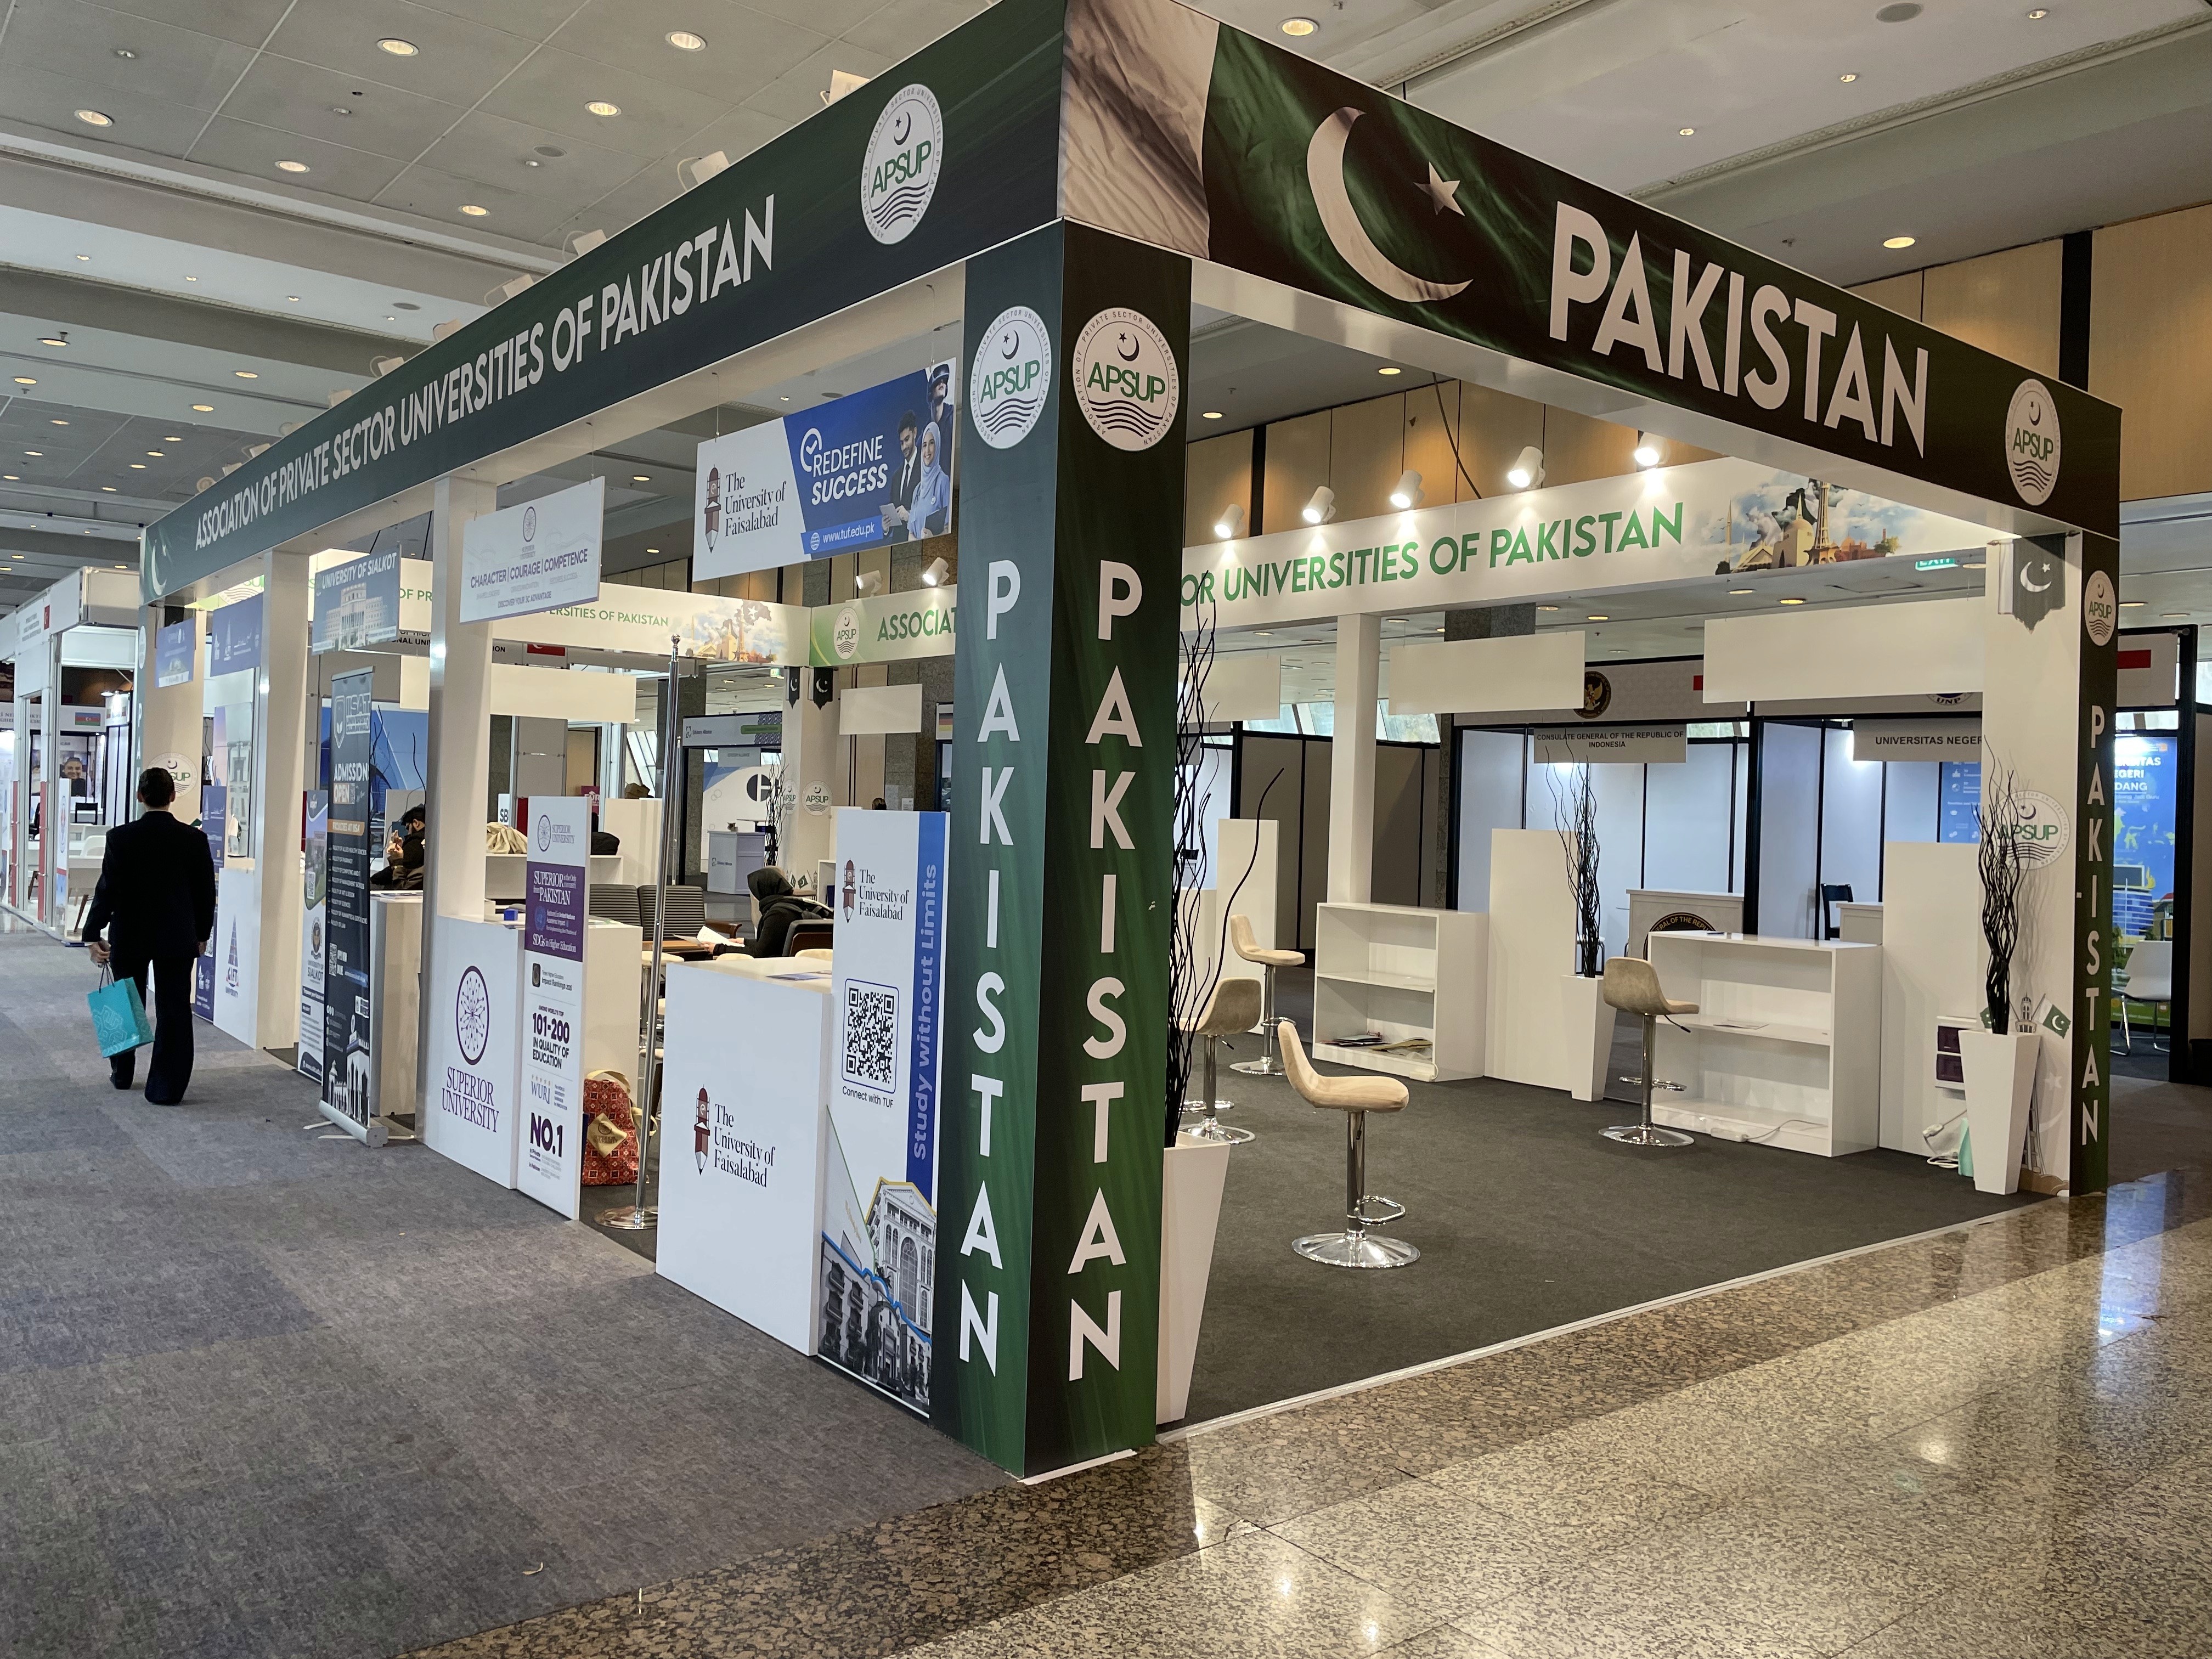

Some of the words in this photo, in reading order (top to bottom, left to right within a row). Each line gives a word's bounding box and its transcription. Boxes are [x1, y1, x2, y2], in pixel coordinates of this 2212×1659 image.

[870, 140, 932, 198] APSUP
[1549, 200, 1929, 459] PAKISTAN
[196, 481, 258, 551] ASSOCIATION
[261, 471, 277, 516] OF
[279, 440, 330, 508] PRIVATE
[332, 405, 396, 480] SECTOR
[400, 322, 544, 446] UNIVERSITIES
[551, 294, 594, 372] OF
[601, 194, 774, 351] PAKISTAN
[980, 359, 1040, 403] APSUP
[1087, 362, 1166, 403] APSUP
[812, 435, 883, 478] REDEFINE
[2013, 427, 2053, 462] APSUP
[725, 472, 745, 493] The
[725, 488, 774, 516] University
[775, 481, 787, 503] of
[811, 462, 889, 506] SUCCESS
[725, 506, 778, 537] Faisalabad
[822, 521, 876, 545] www.tuf.edu.pk
[471, 569, 507, 589] CHARACTER
[510, 561, 541, 580] COURAGE
[544, 549, 588, 572] COMPETENCE
[1224, 540, 1419, 601] UNIVERSITIES
[1429, 532, 1481, 575] OF
[1489, 502, 1683, 569] PAKISTAN
[321, 565, 357, 590] UNIVERSITY
[358, 561, 368, 579] OF
[367, 552, 397, 576] SIALKOT
[599, 610, 615, 621] OF
[618, 612, 669, 627] PAKISTAN
[2089, 600, 2112, 619] APSUP
[837, 629, 856, 641] APSUP
[1875, 736, 1944, 746] UNIVERSITAS
[2114, 769, 2145, 778] EGERI
[2114, 782, 2148, 791] DANG
[806, 795, 829, 803] APSUP
[534, 870, 564, 888] SUPERIOR
[859, 869, 876, 884] The
[539, 887, 571, 906] PAKISTAN
[859, 885, 899, 907] University
[900, 889, 910, 904] of
[859, 901, 902, 921] Faisalabad
[921, 864, 937, 949] Limits
[959, 560, 1022, 1378] PAKISTAN
[1066, 560, 1143, 1382] PAKISTAN
[532, 1012, 570, 1044] 101-200
[916, 955, 934, 1068] without
[532, 1048, 562, 1070] EDUCATION
[533, 1036, 539, 1048] IN
[539, 1039, 561, 1057] QUALITY
[561, 1046, 569, 1059] OF
[447, 1066, 494, 1106] SUPERIOR
[842, 1086, 867, 1102] Connect
[868, 1093, 881, 1105] with
[882, 1097, 894, 1108] TUF
[442, 1087, 499, 1133] UNIVERSITY
[714, 1103, 734, 1127] The
[913, 1073, 933, 1160] Study
[530, 1111, 563, 1158] NO.1
[714, 1126, 763, 1166] University
[764, 1146, 776, 1166] of
[714, 1149, 767, 1188] Faisalabad
